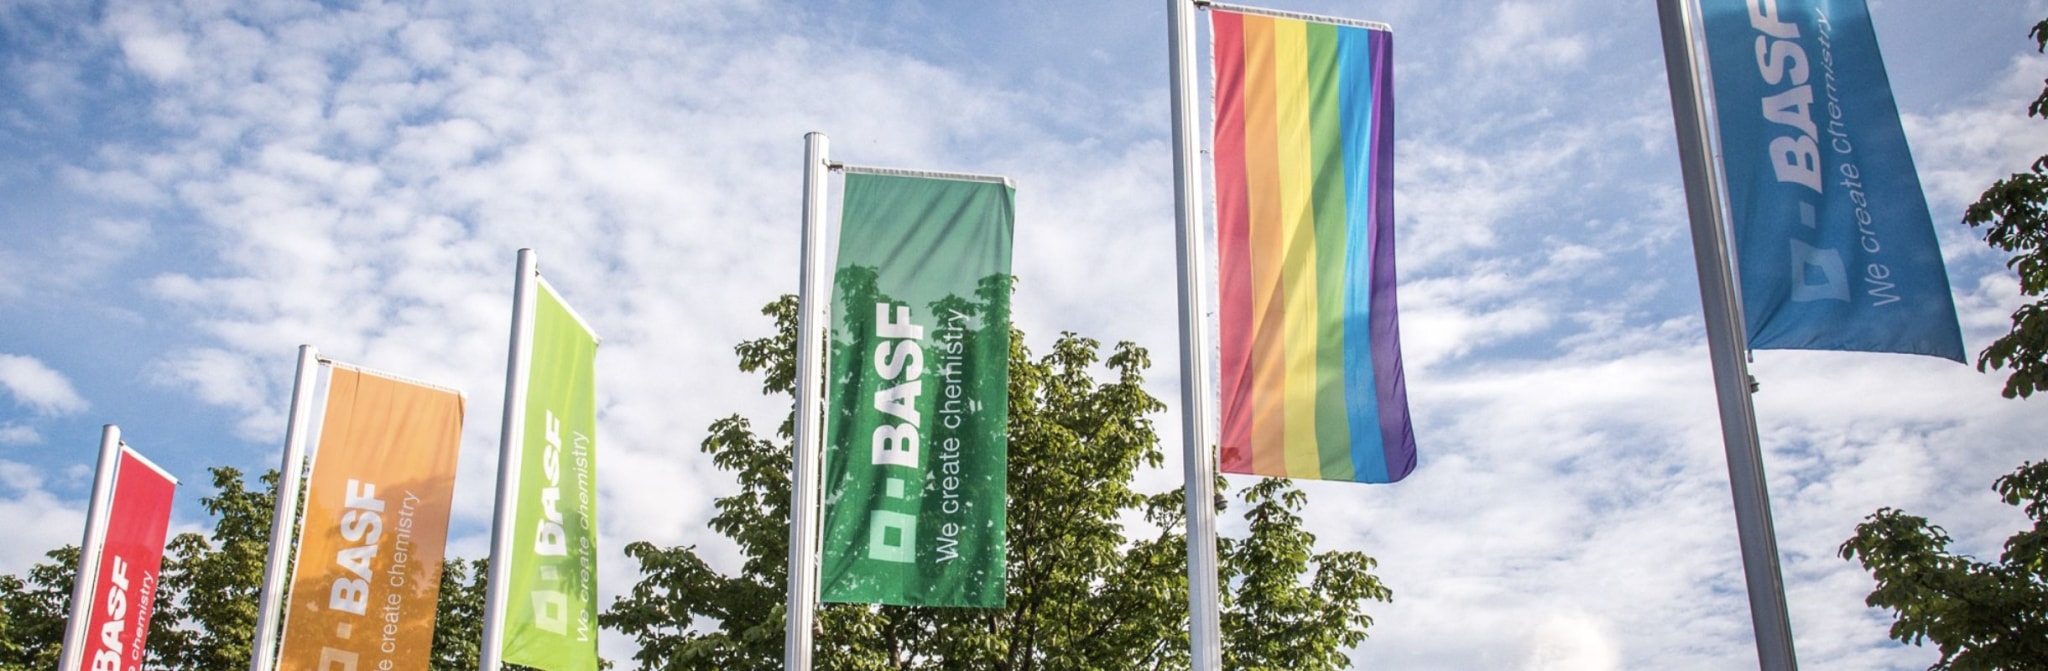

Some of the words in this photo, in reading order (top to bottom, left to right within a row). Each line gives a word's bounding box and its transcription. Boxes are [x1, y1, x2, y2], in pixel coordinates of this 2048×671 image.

[1747, 0, 1823, 194] BASF
[1816, 7, 1852, 154] chemistry
[1840, 162, 1880, 252] create
[1864, 261, 1900, 307] We
[871, 302, 924, 468] BASF
[938, 308, 970, 430] chemistry
[534, 409, 568, 556] BASF
[572, 431, 590, 530] chemistry
[939, 437, 960, 514] create
[329, 478, 386, 616] BASF
[387, 490, 420, 588] chemistry
[580, 536, 590, 603] create
[936, 522, 959, 564] We
[91, 555, 129, 671] BASF
[132, 570, 154, 661] chemistry
[381, 593, 401, 653] create
[576, 611, 589, 643] We
